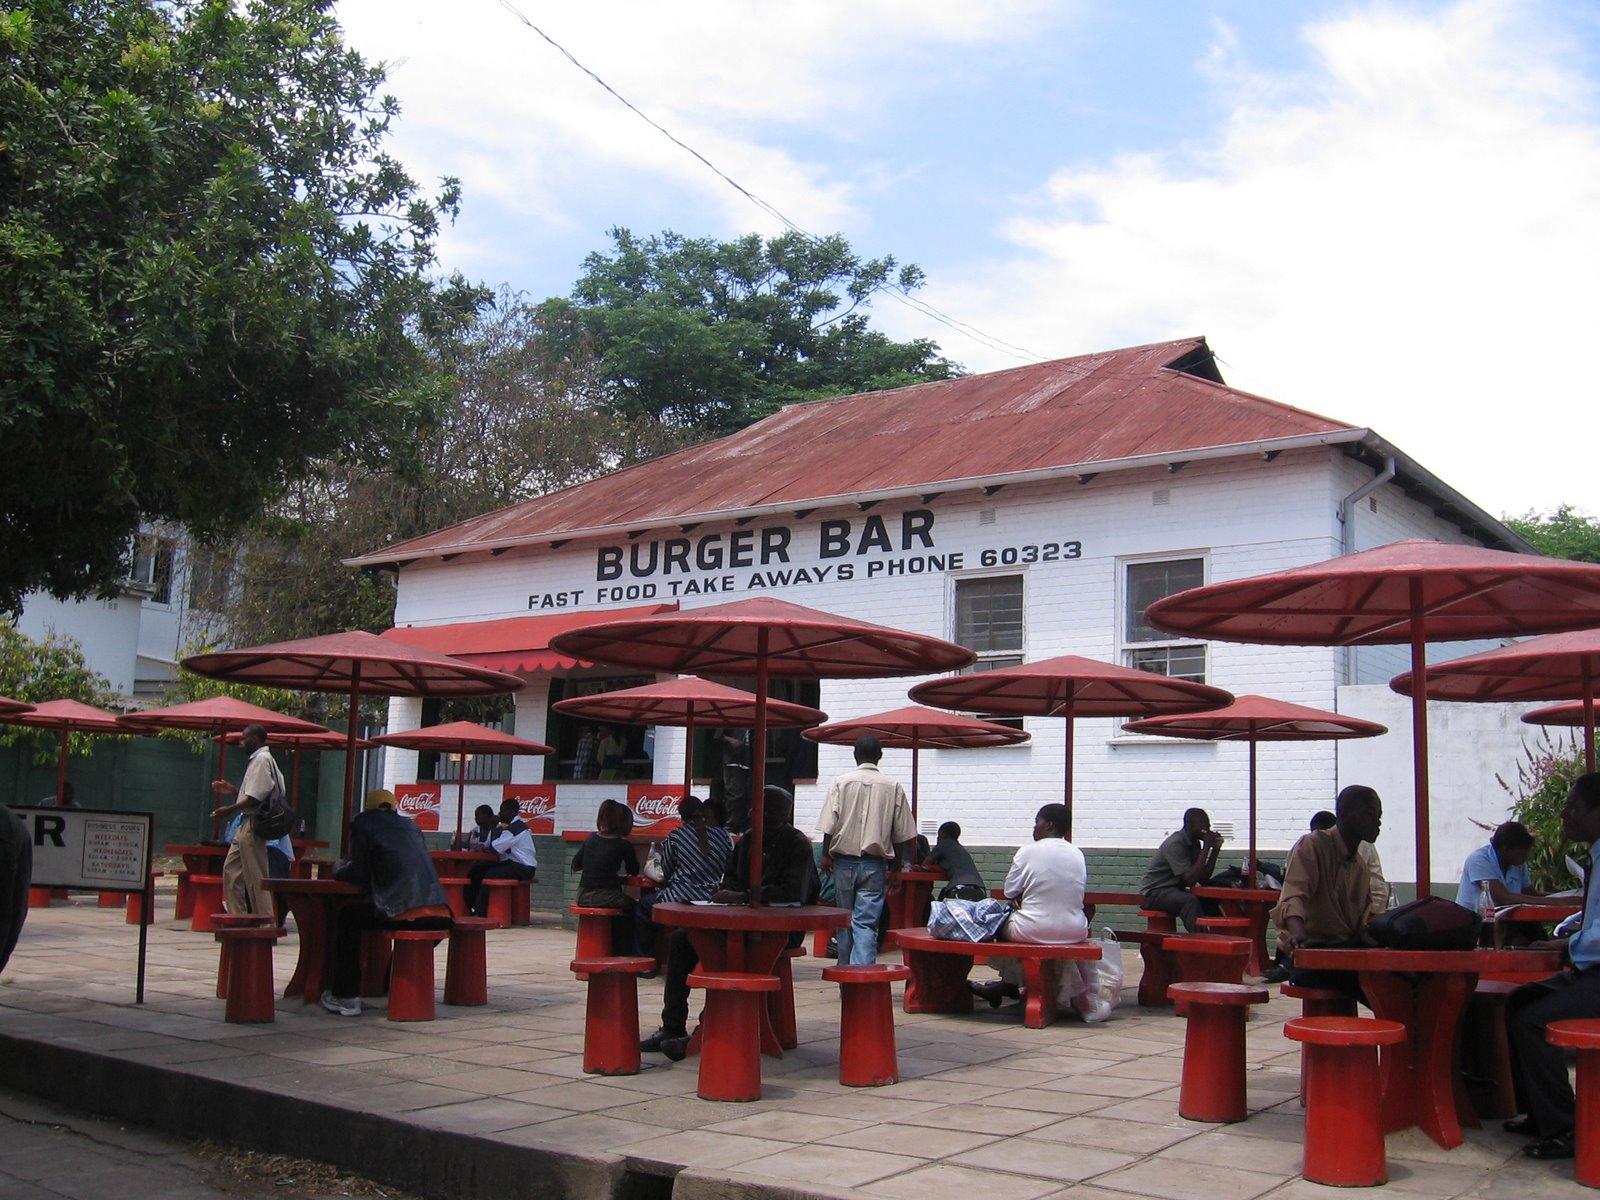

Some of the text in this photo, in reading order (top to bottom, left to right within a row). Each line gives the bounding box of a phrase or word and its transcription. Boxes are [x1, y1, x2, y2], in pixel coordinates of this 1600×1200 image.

[528, 541, 1082, 610] FAST FOOD TAKE AWAYS PHONE 60323
[596, 509, 935, 582] BURGER BAR
